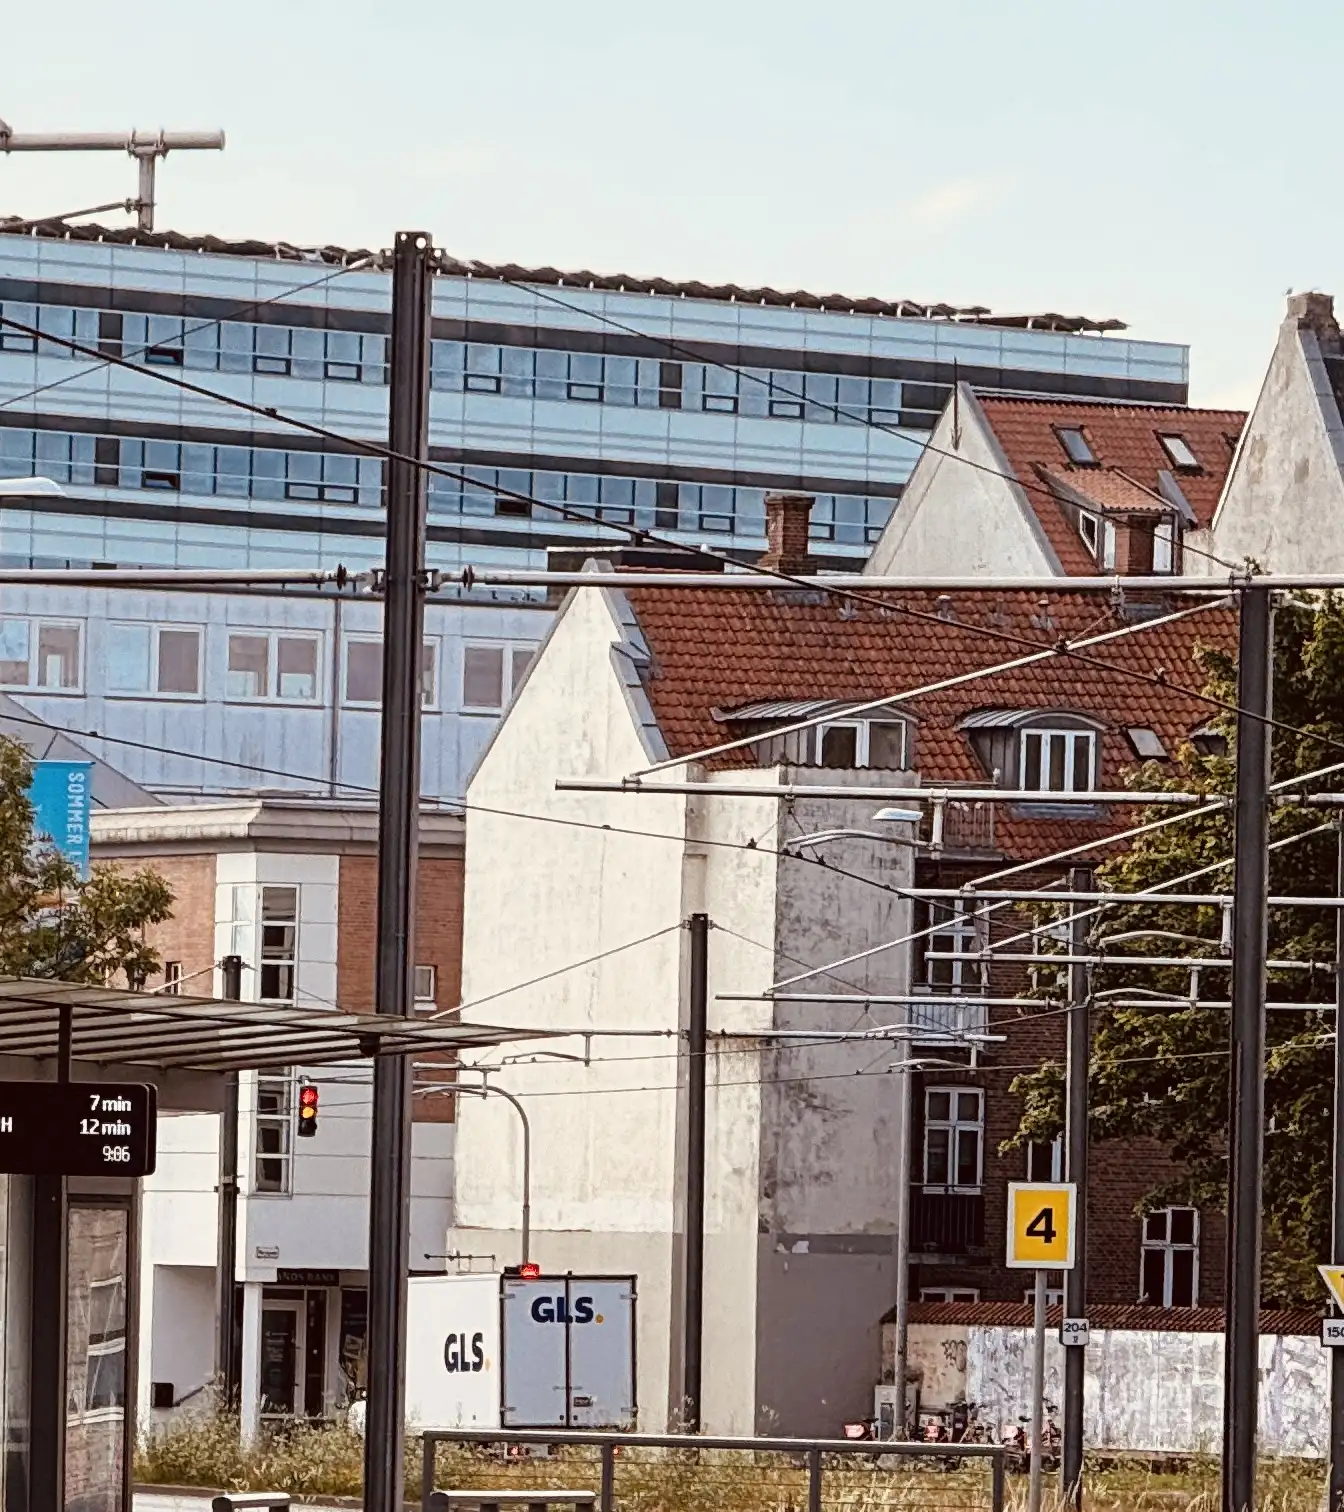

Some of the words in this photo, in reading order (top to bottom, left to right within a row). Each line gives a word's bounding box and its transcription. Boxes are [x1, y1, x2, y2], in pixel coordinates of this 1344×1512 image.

[66, 772, 85, 844] SOMMER
[89, 1094, 100, 1111] 7
[102, 1095, 132, 1112] min
[0, 1116, 13, 1133] H
[79, 1118, 100, 1135] 12
[101, 1119, 132, 1136] min
[102, 1145, 131, 1163] 9:06
[1025, 1207, 1057, 1244] 4
[1063, 1322, 1088, 1333] 204
